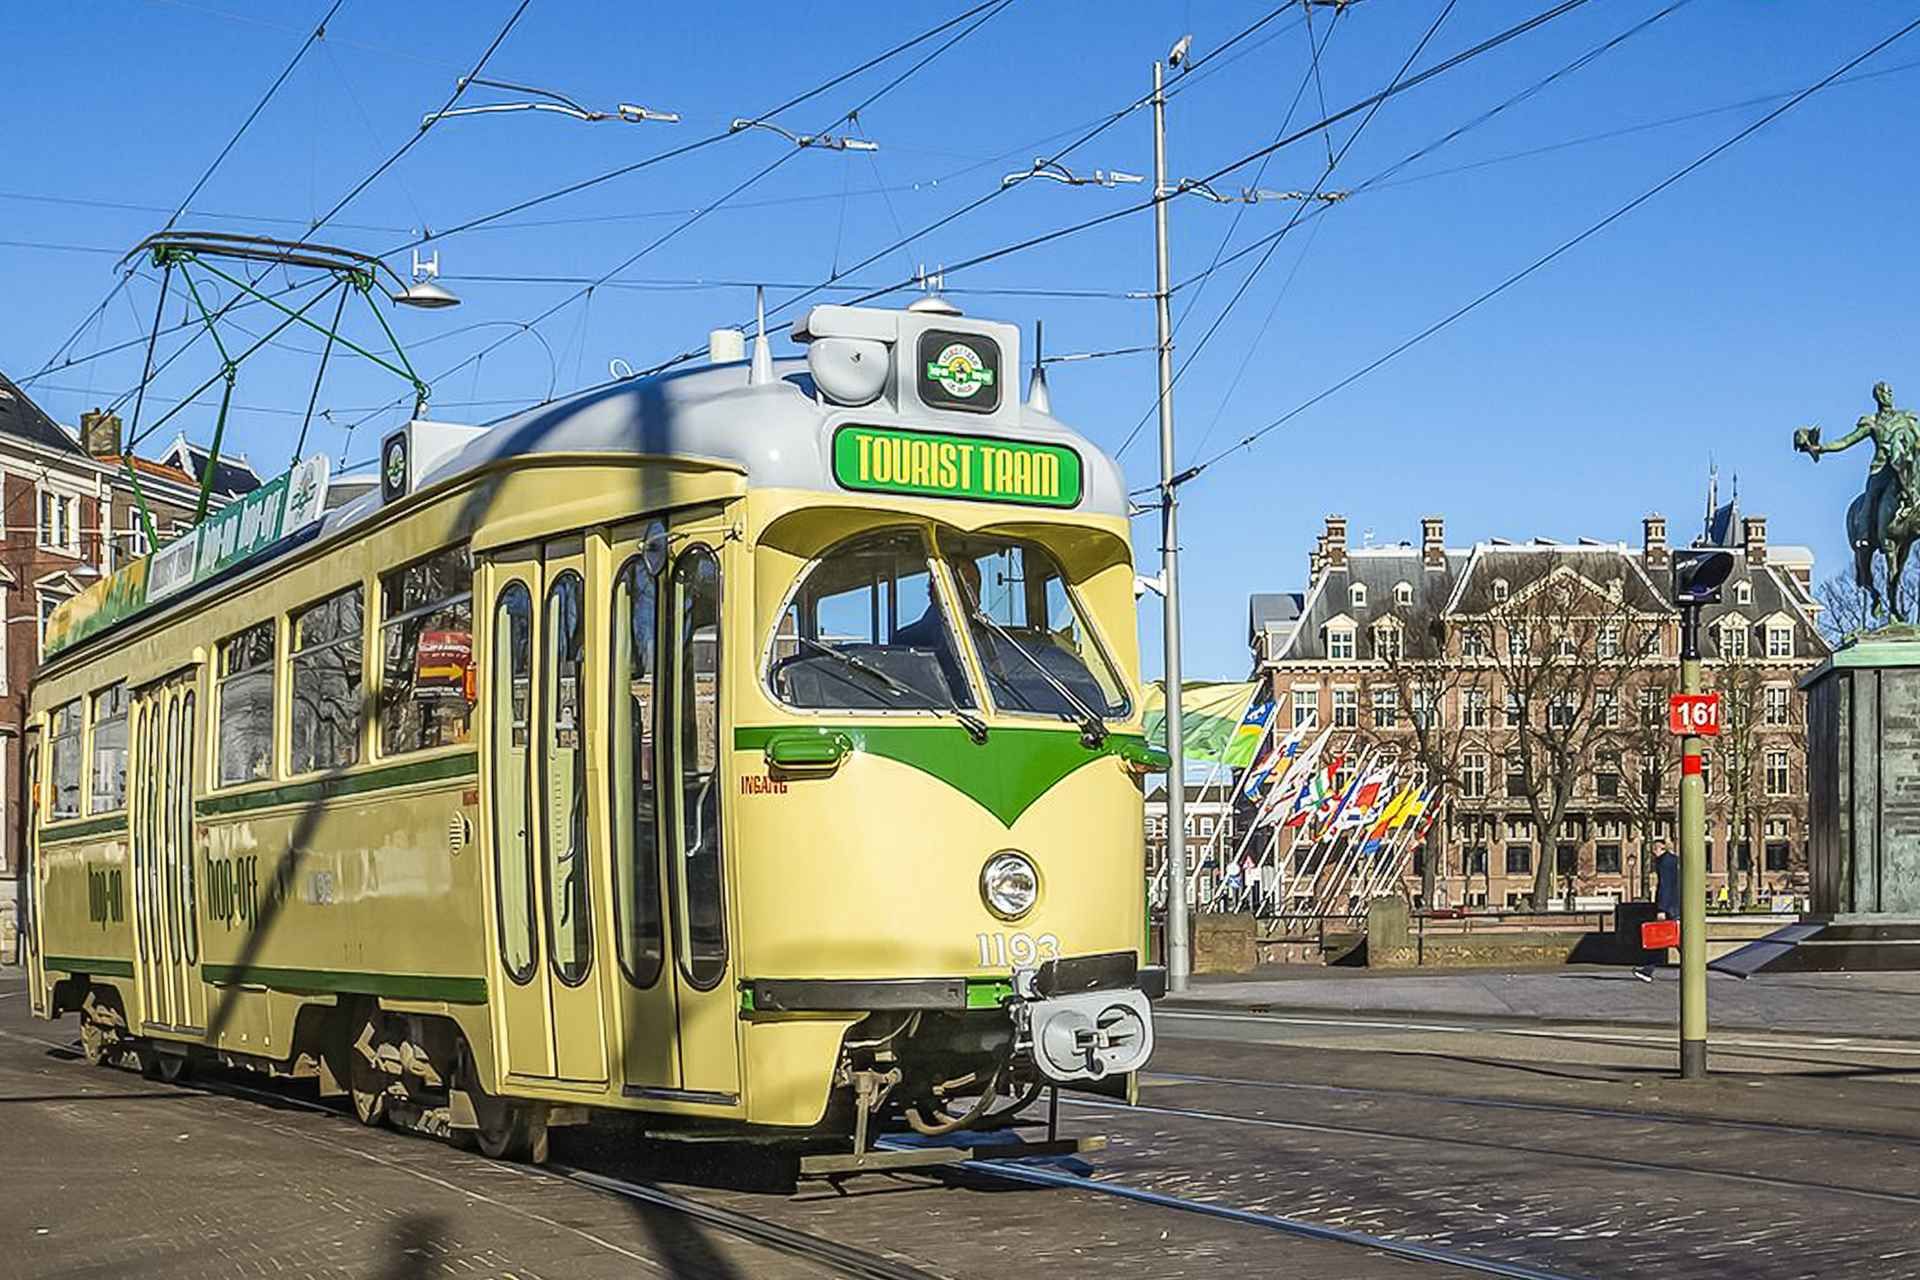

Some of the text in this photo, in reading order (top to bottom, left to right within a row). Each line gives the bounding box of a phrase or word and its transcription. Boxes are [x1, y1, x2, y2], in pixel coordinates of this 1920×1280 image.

[856, 435, 1060, 497] TOURIST TRAM
[1677, 702, 1717, 726] 161
[206, 847, 258, 931] hop-off
[976, 932, 1060, 968] 1193
